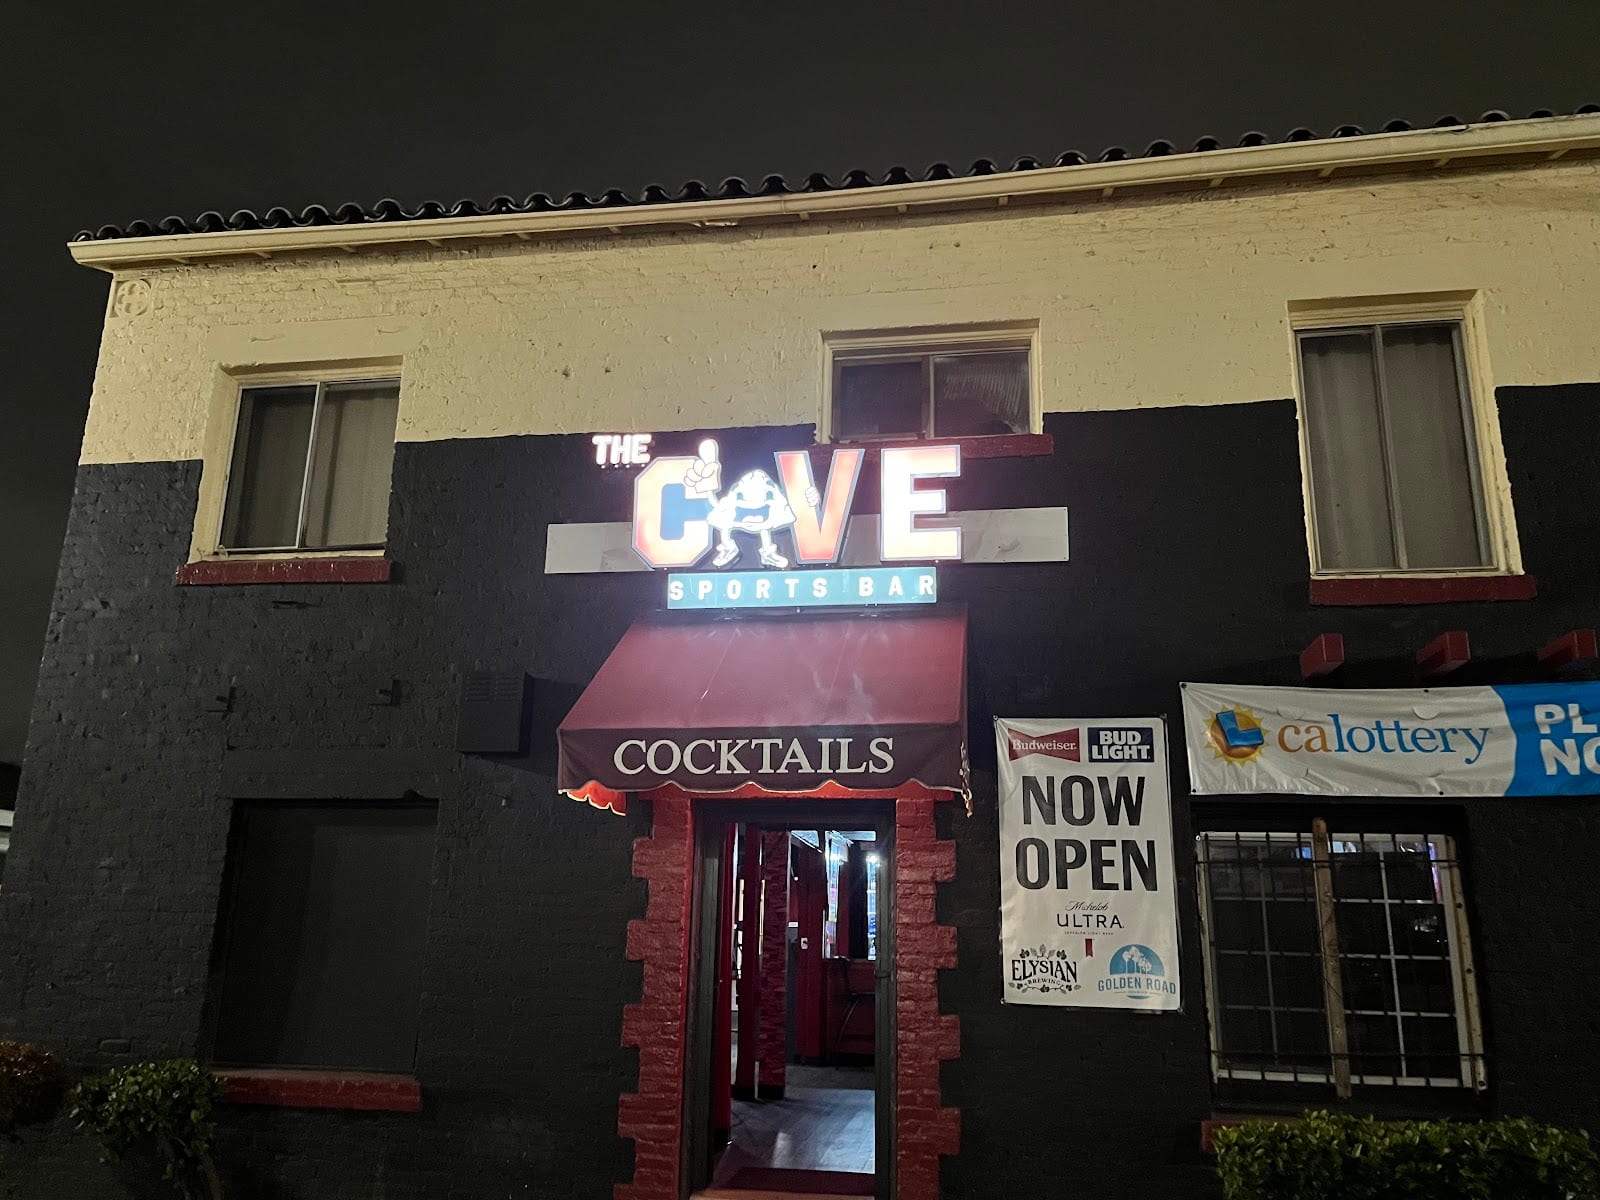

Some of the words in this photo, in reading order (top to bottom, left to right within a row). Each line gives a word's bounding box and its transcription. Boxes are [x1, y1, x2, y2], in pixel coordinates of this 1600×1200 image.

[592, 434, 652, 465] THE
[669, 577, 828, 601] SPORTS
[858, 574, 935, 597] BAR
[1534, 703, 1599, 735] PL
[1012, 739, 1077, 751] Budweiser
[1099, 730, 1142, 745] BUD
[1277, 713, 1491, 764] calottery
[612, 737, 895, 776] COCKTAILS
[1091, 744, 1151, 760] LIGHT
[1021, 775, 1145, 827] NOW
[1015, 837, 1158, 892] OPEN
[1064, 900, 1109, 912] Michelob
[1056, 913, 1123, 929] ULTRA
[1011, 959, 1078, 983] ELYSIAN
[1097, 977, 1142, 992] GOLDEN
[1146, 977, 1177, 995] ROAD
